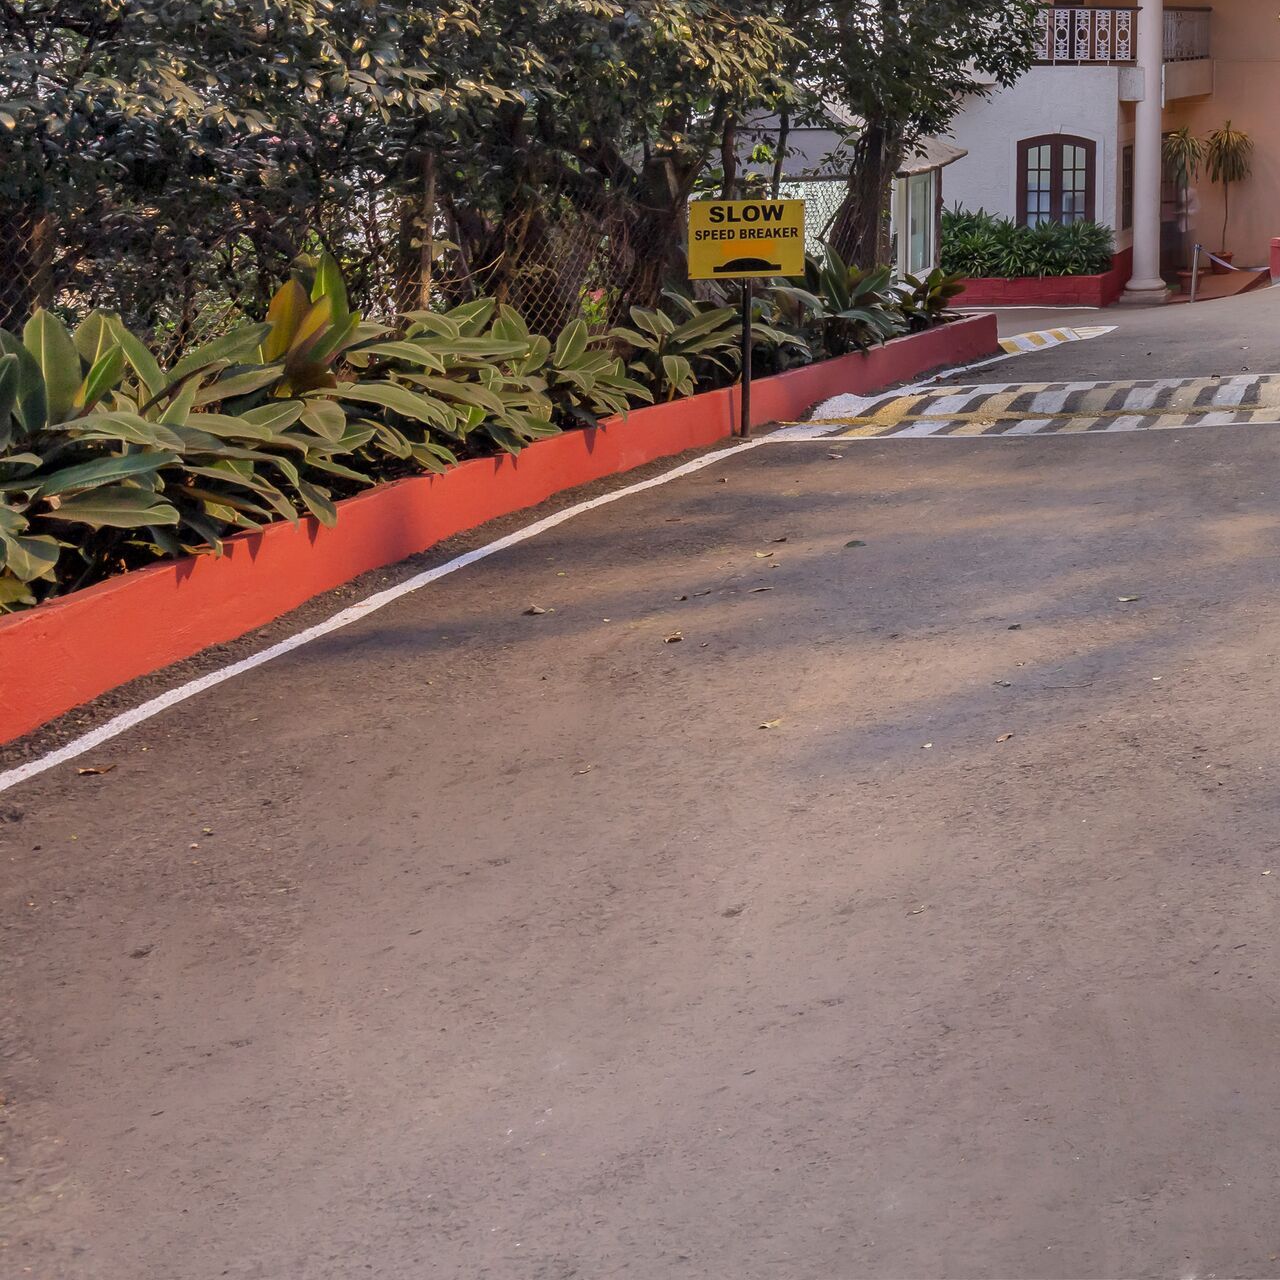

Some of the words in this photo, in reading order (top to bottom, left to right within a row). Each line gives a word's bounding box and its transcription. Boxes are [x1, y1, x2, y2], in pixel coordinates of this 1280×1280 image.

[709, 204, 784, 223] SLOW
[695, 229, 735, 240] SPEED
[739, 227, 798, 239] BREAKER
